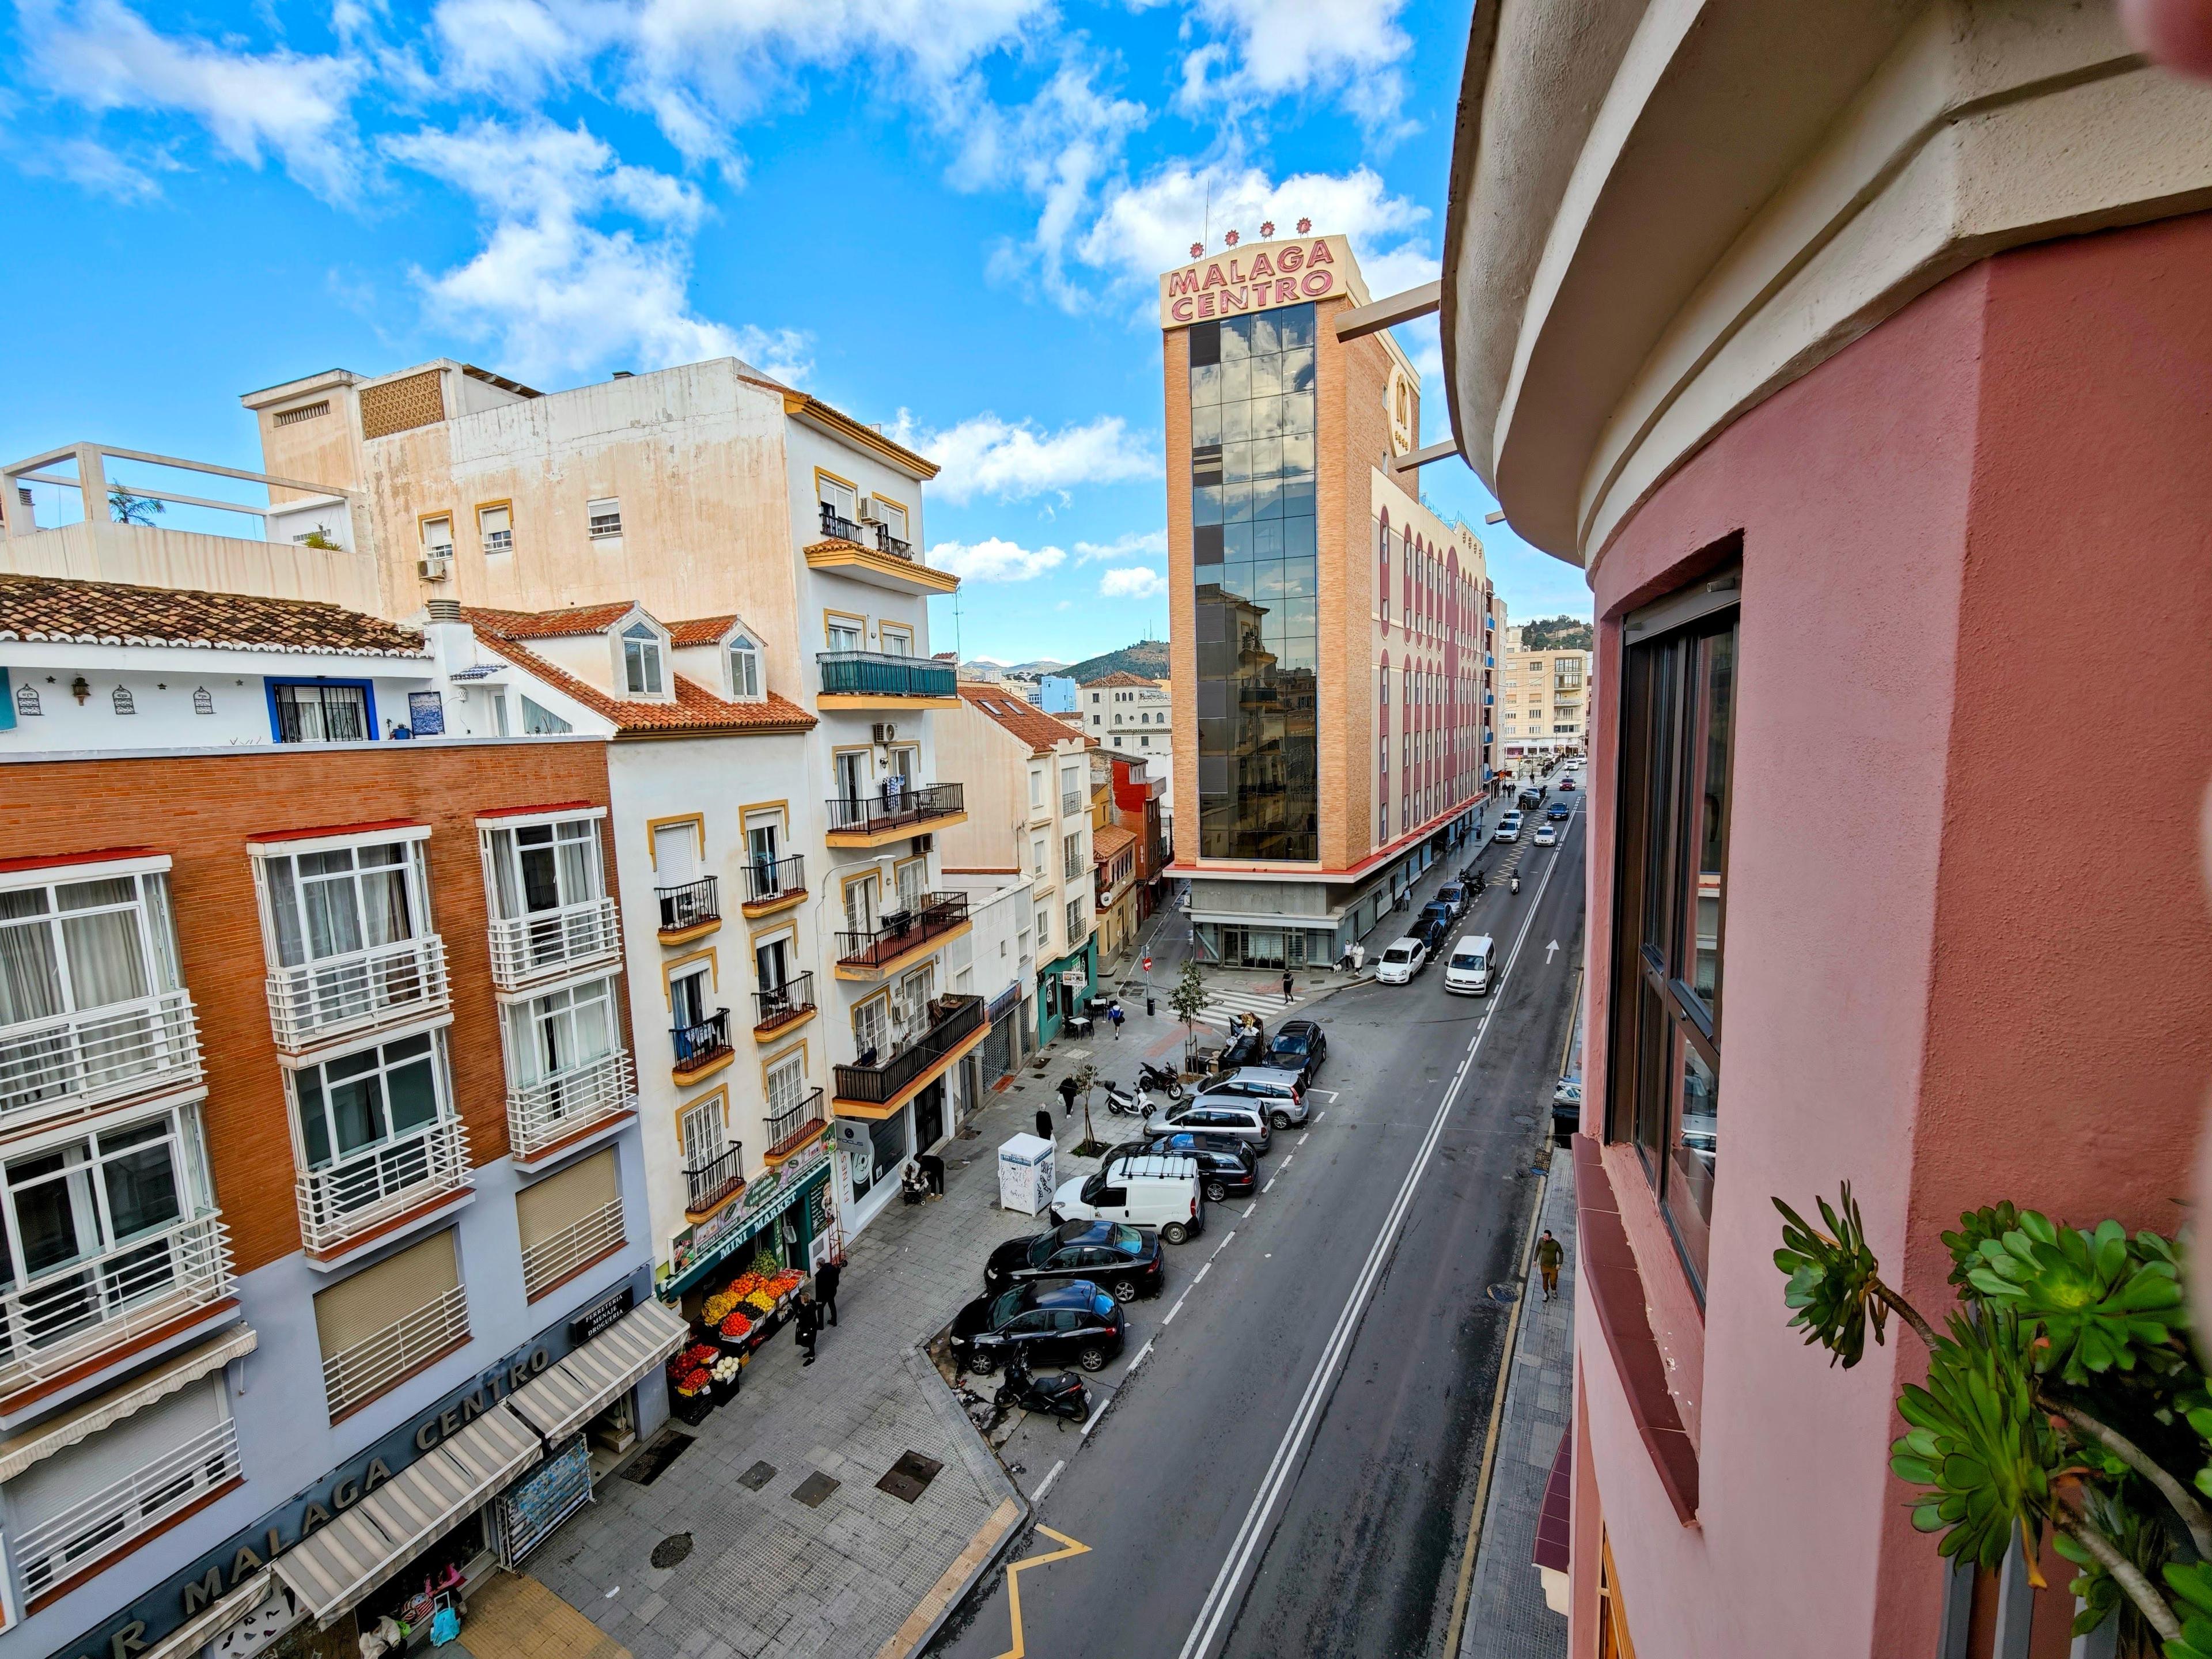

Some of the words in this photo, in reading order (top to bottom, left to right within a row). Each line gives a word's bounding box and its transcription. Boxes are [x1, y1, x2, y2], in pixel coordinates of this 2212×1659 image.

[1169, 239, 1334, 297] MALAGA
[1171, 269, 1334, 321] CENTRO
[838, 1138, 863, 1146] FOCUS
[840, 1149, 850, 1203] FITNES
[700, 1236, 714, 1251] FRUTAS
[720, 1230, 748, 1260] MINI
[753, 1191, 797, 1233] MARKET
[585, 1294, 623, 1323] FERRETERIA
[588, 1309, 623, 1336] DROGUERIA
[593, 1305, 617, 1325] MENAJE
[184, 1457, 392, 1614] MALAGA
[416, 1347, 548, 1450] CENTRO
